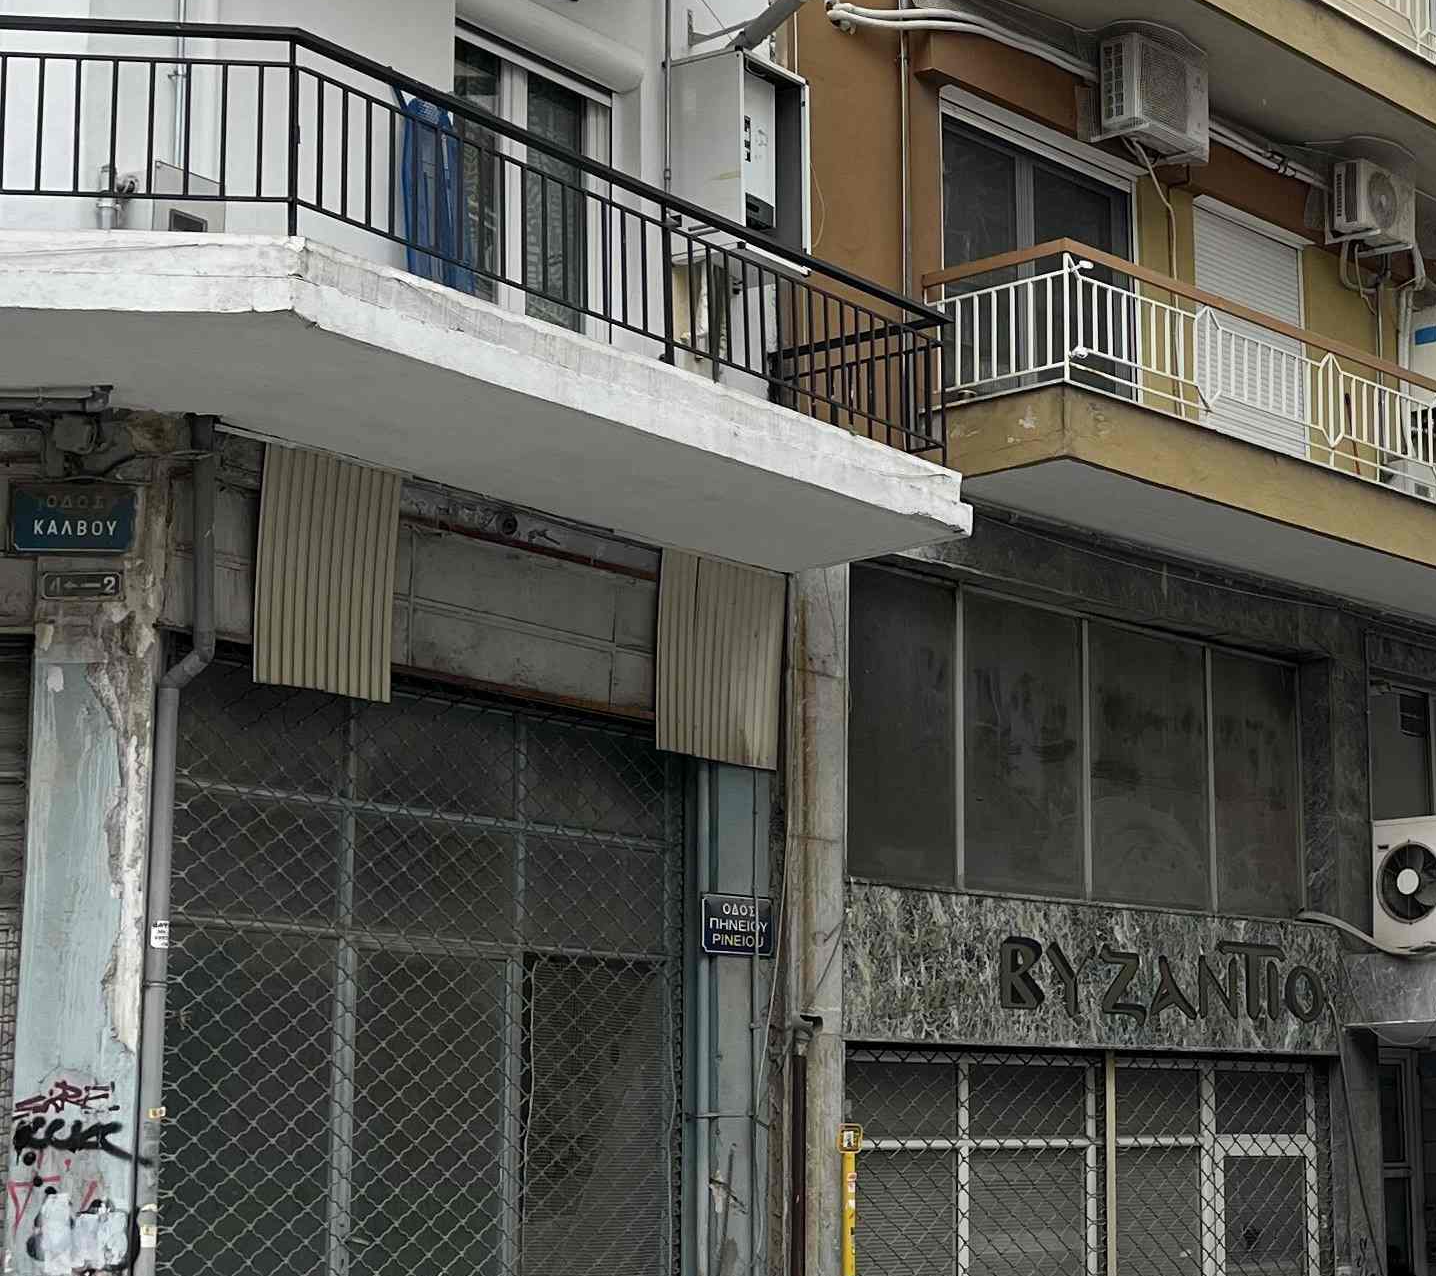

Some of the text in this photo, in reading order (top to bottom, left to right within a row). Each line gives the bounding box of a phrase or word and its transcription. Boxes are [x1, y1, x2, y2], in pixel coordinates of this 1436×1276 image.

[33, 519, 118, 536] ΚΑΛΒΟΥ
[103, 576, 116, 594] 2
[722, 903, 756, 917] ΟΔΟΣ
[709, 917, 768, 933] ΠΗΝΕΙΟΥ
[1000, 935, 1325, 1023] BYZANTIO
